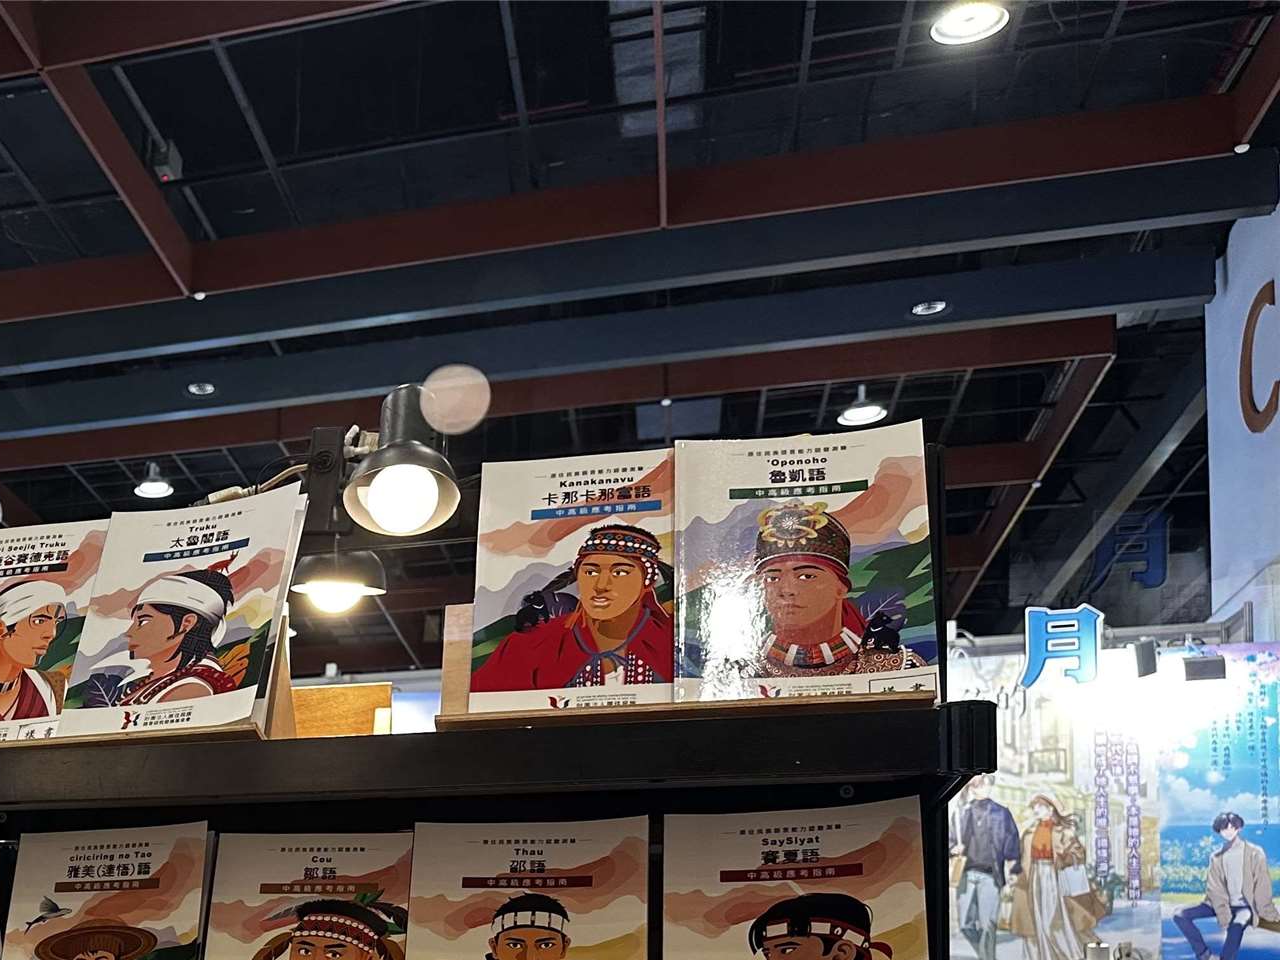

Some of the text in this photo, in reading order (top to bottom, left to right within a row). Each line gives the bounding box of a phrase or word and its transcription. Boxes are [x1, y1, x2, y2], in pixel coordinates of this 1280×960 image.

[769, 468, 826, 483] 魯凱語
[560, 477, 634, 488] Kanakanavu
[542, 485, 651, 506] 卡那卡那富語
[189, 524, 217, 533] Truku
[170, 529, 230, 548] 太魯閣語
[1020, 604, 1104, 689] 月
[118, 852, 130, 860] no
[134, 851, 152, 859] Tao
[514, 848, 543, 856] Thau
[761, 848, 820, 865] 賽夏語
[509, 860, 546, 873] 邵語
[304, 867, 337, 880] 鄒語
[747, 867, 836, 880] 中高級應考指南
